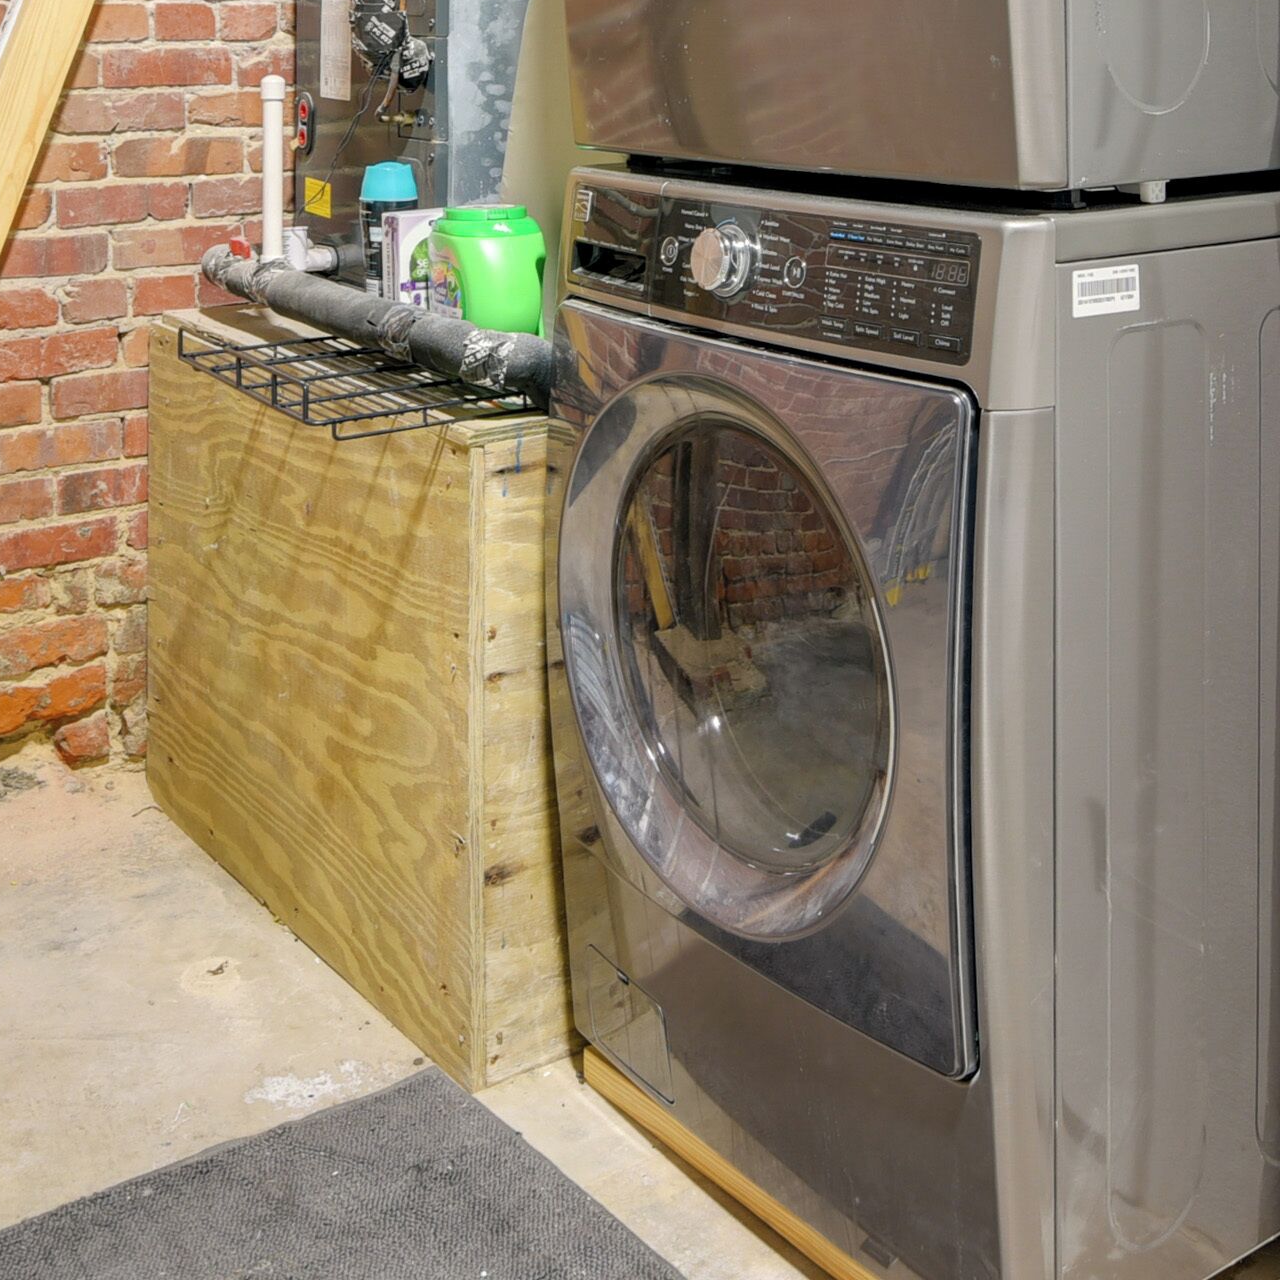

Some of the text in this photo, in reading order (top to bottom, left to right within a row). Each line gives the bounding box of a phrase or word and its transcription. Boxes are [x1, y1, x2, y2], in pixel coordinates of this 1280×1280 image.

[938, 287, 956, 295] Connect
[855, 324, 879, 335] Spin Speed
[902, 333, 915, 341] Level
[935, 338, 950, 347] Chime
